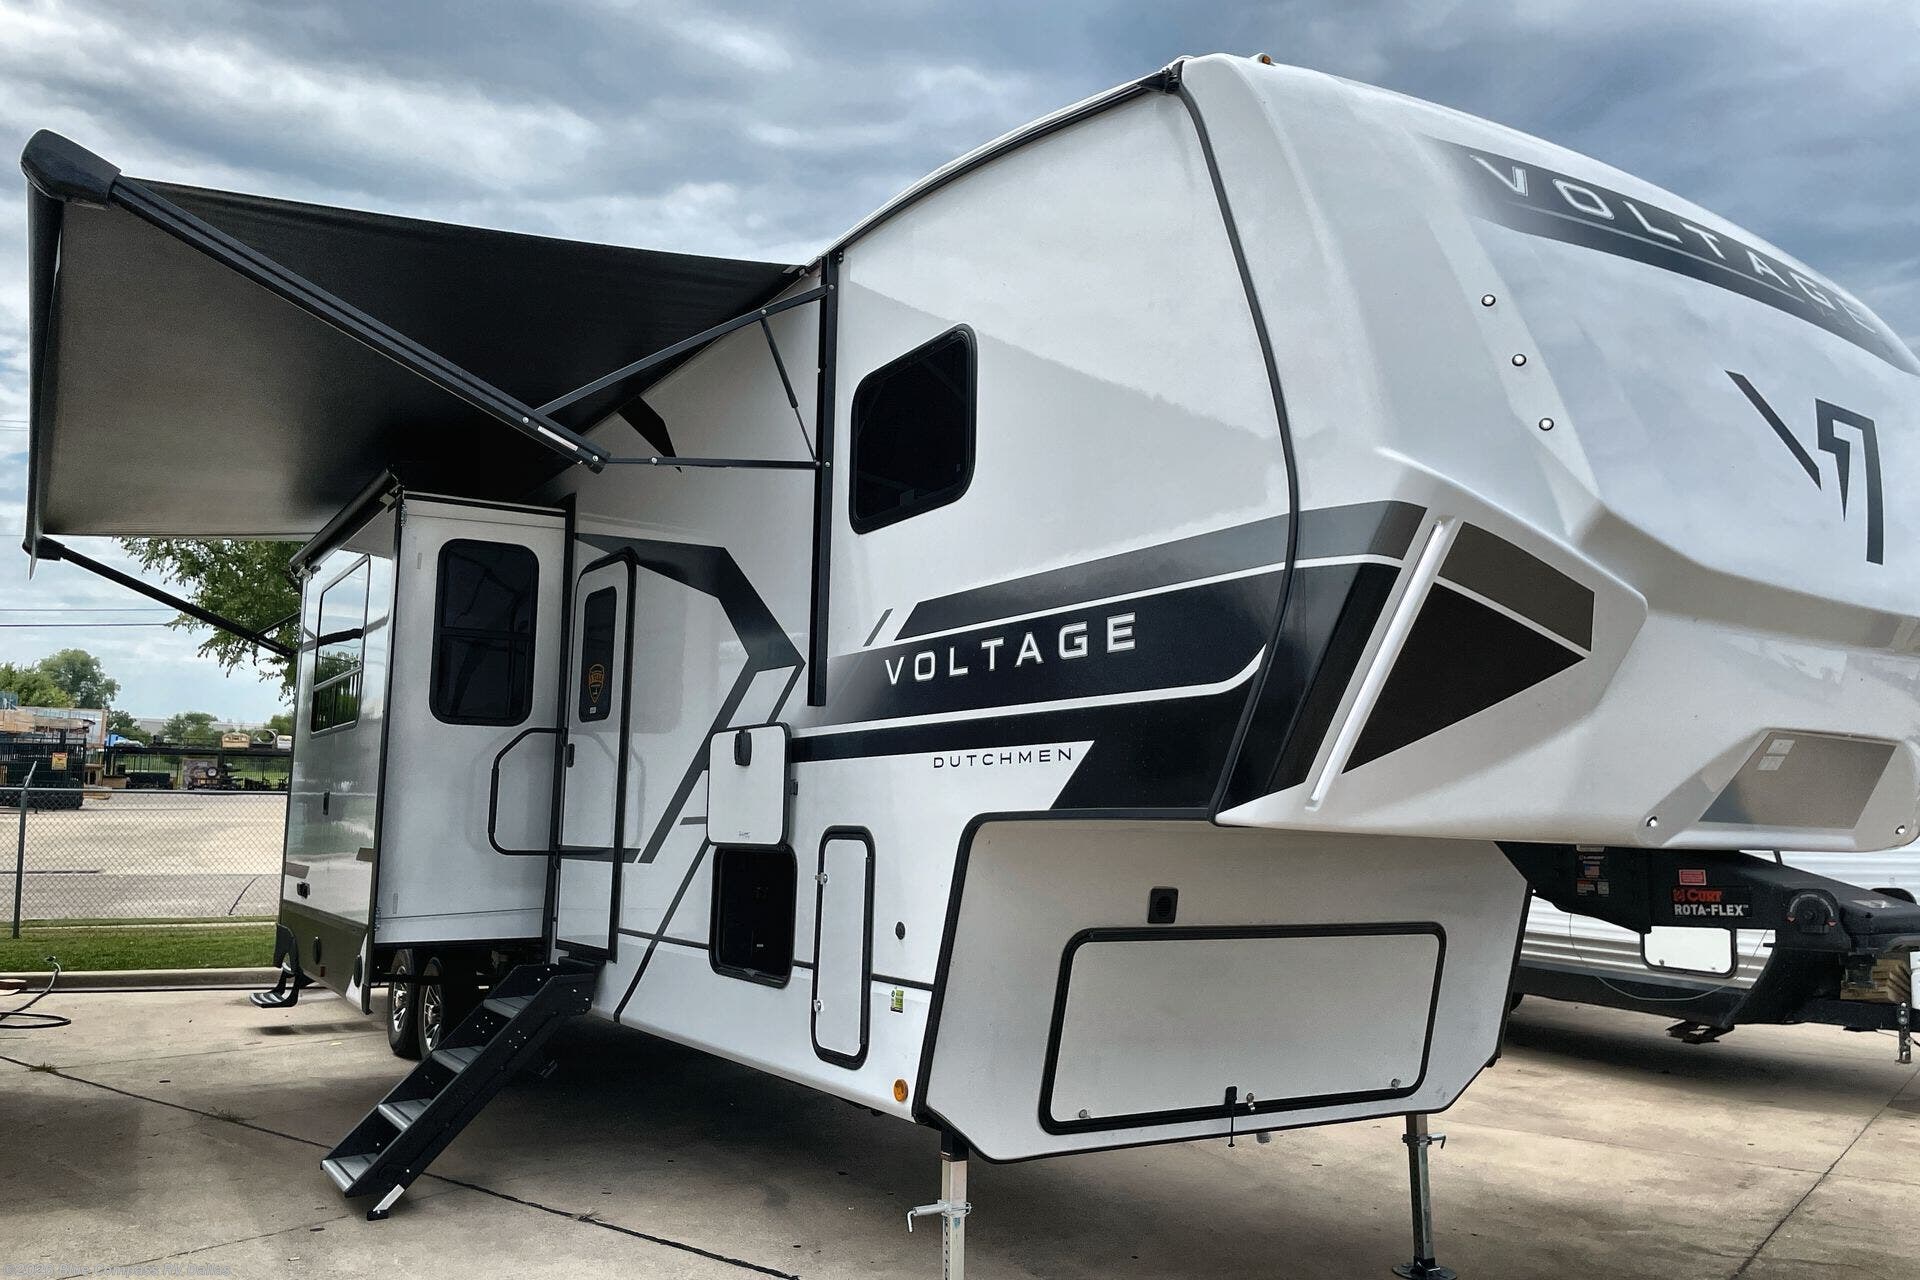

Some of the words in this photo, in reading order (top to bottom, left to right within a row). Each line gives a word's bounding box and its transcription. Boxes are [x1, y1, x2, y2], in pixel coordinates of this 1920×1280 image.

[1470, 154, 1877, 334] VOLTAGE
[885, 611, 1136, 686] VOLTAGE
[932, 747, 1073, 769] DUTCHMEN
